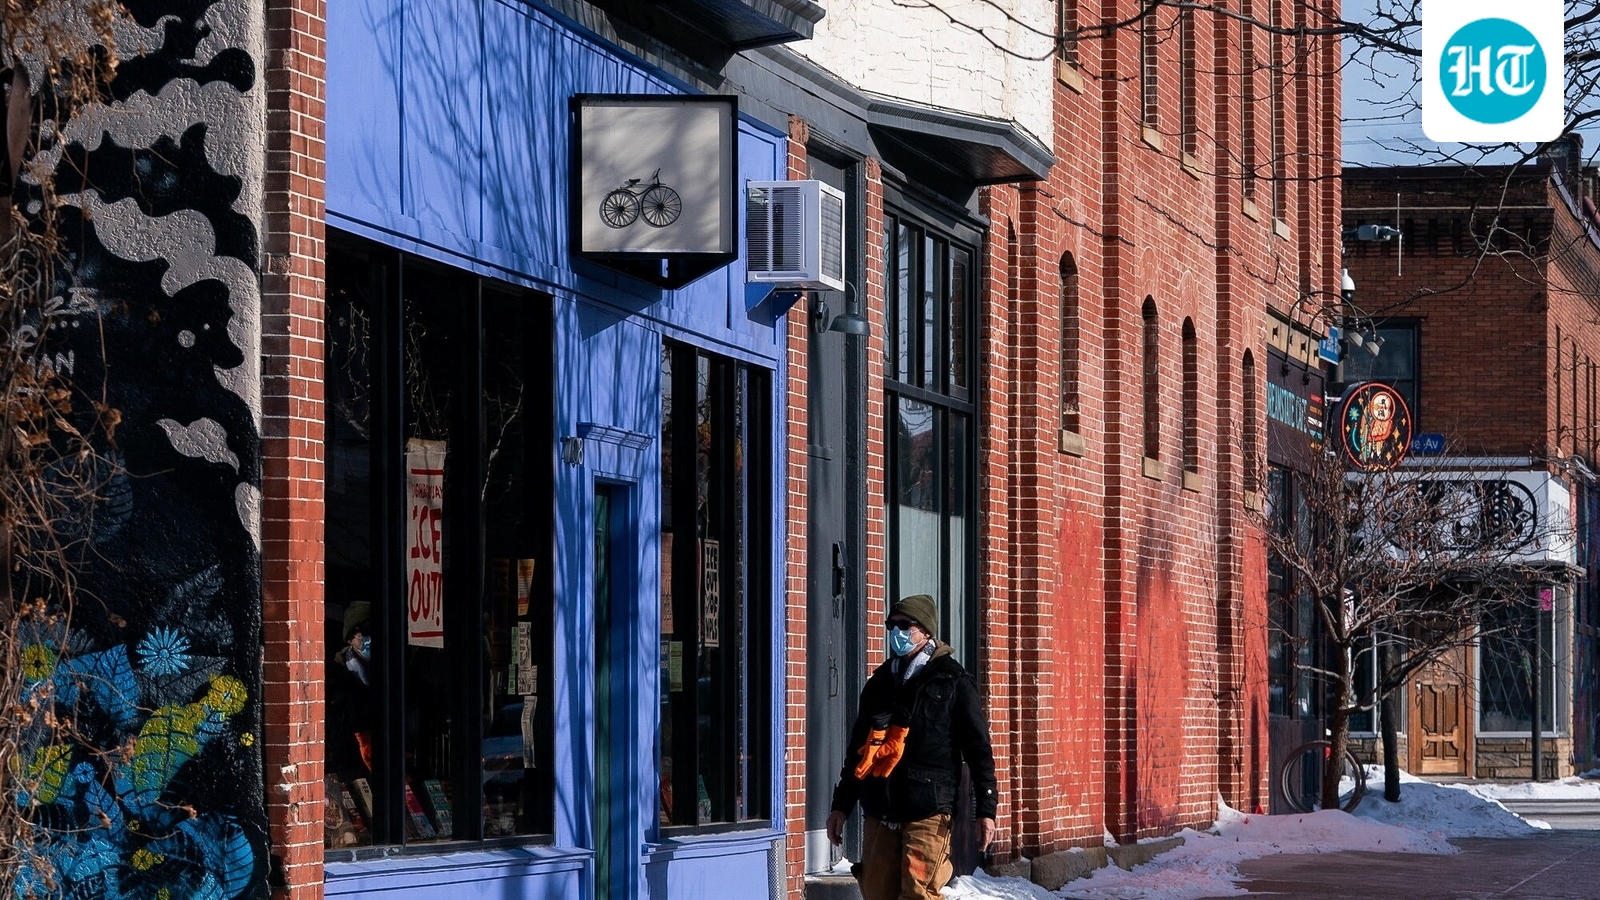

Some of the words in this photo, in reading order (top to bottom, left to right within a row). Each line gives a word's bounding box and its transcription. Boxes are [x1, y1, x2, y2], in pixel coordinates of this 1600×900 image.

[1425, 437, 1439, 450] Av
[411, 505, 442, 564] ICE
[706, 546, 718, 570] ICE
[410, 568, 442, 627] OUT!
